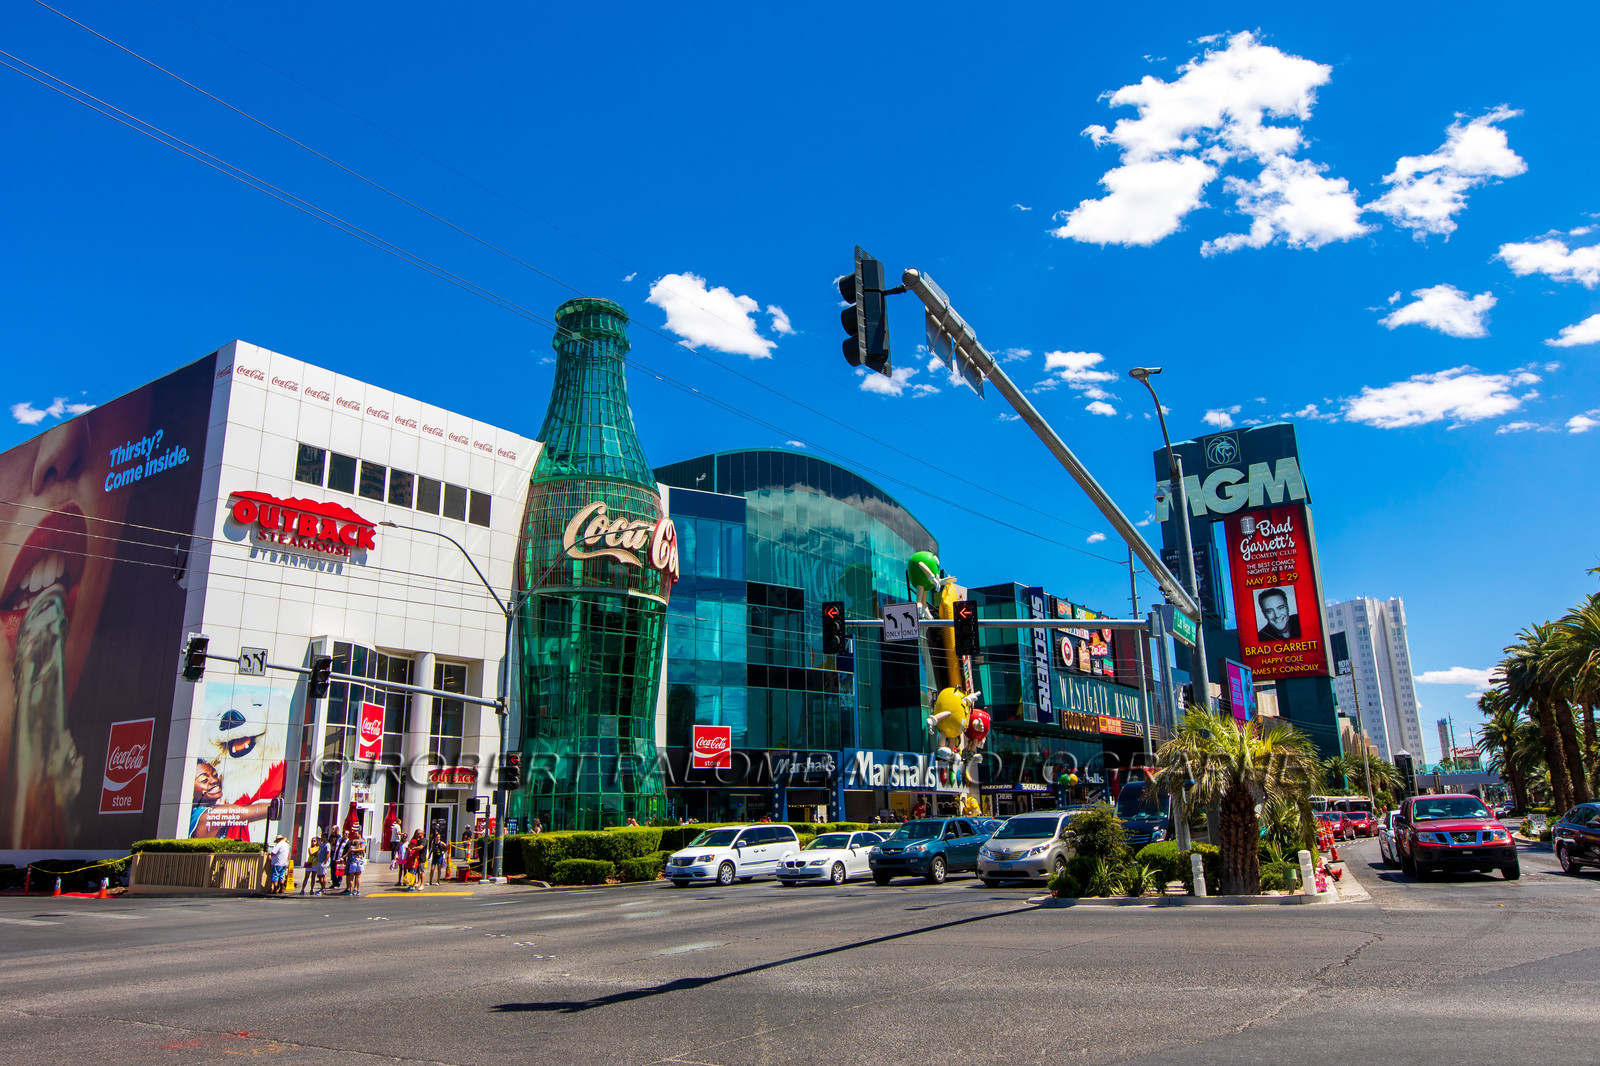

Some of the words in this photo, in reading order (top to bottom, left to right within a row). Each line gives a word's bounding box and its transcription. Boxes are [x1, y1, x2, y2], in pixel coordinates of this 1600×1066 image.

[110, 428, 164, 468] Thirsty?
[104, 464, 143, 492] Come
[144, 445, 190, 478] inside.
[1155, 456, 1307, 523] MGM
[233, 499, 376, 551] OUTBACK
[1255, 516, 1293, 537] Brad
[258, 530, 351, 558] STEAKHOUSE
[1240, 534, 1296, 561] Garrett's
[1251, 550, 1278, 560] COMEDY
[1279, 548, 1297, 557] CLUB
[1271, 558, 1295, 568] COMICS
[1246, 576, 1264, 587] MAY
[1266, 575, 1277, 584] 28
[1286, 572, 1298, 582] 29
[1247, 568, 1270, 576] NIGHTLY
[1245, 645, 1272, 656] BRAD
[1273, 640, 1318, 653] GARRETT
[1261, 656, 1284, 665] HAPPY
[1285, 654, 1304, 663] COLE
[1252, 667, 1271, 676] AMES
[1279, 663, 1319, 673] CONNOLLY
[704, 760, 721, 768] store
[773, 756, 836, 775] Marshalls
[848, 751, 936, 788] Marshalls
[431, 773, 476, 784] OUTBACK
[112, 795, 132, 807] store
[221, 813, 240, 821] make
